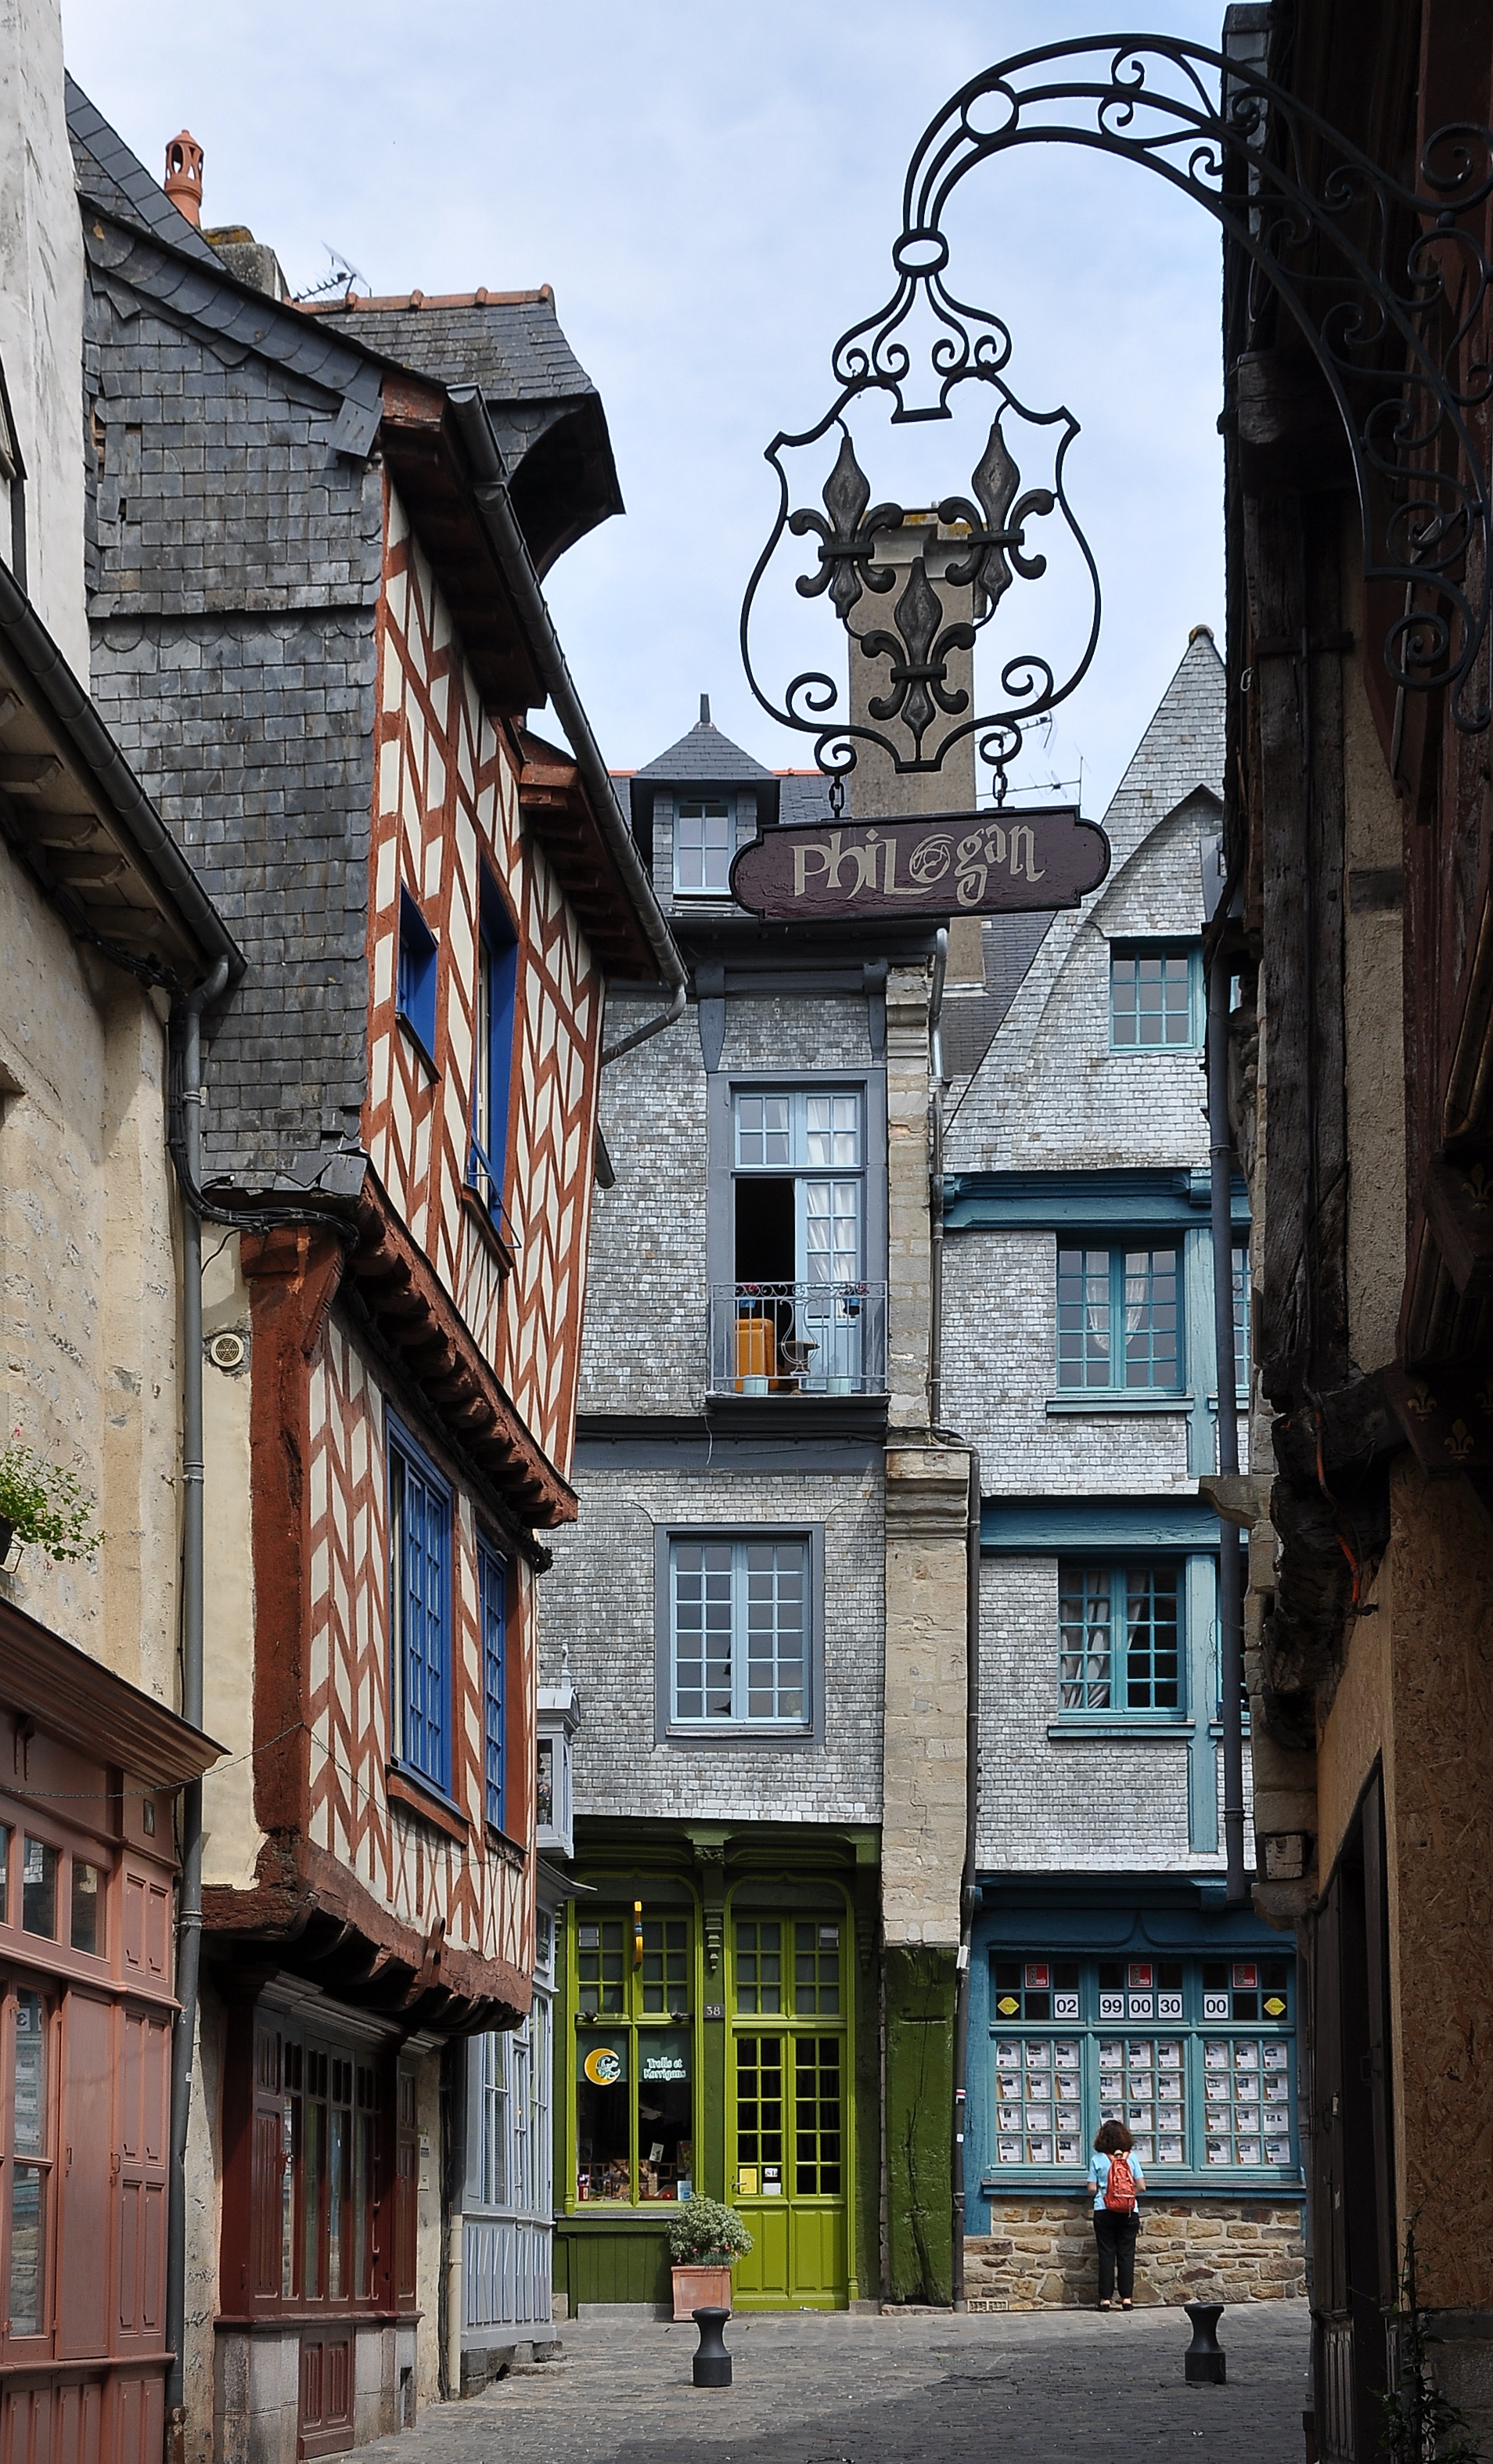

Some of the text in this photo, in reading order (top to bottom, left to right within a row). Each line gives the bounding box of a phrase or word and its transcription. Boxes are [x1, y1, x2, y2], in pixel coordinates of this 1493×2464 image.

[707, 2006, 721, 2016] 38
[1056, 1999, 1226, 2013] 02 99 00 30 00
[646, 2057, 683, 2069] Trolls et
[643, 2068, 686, 2081] Korrigans
